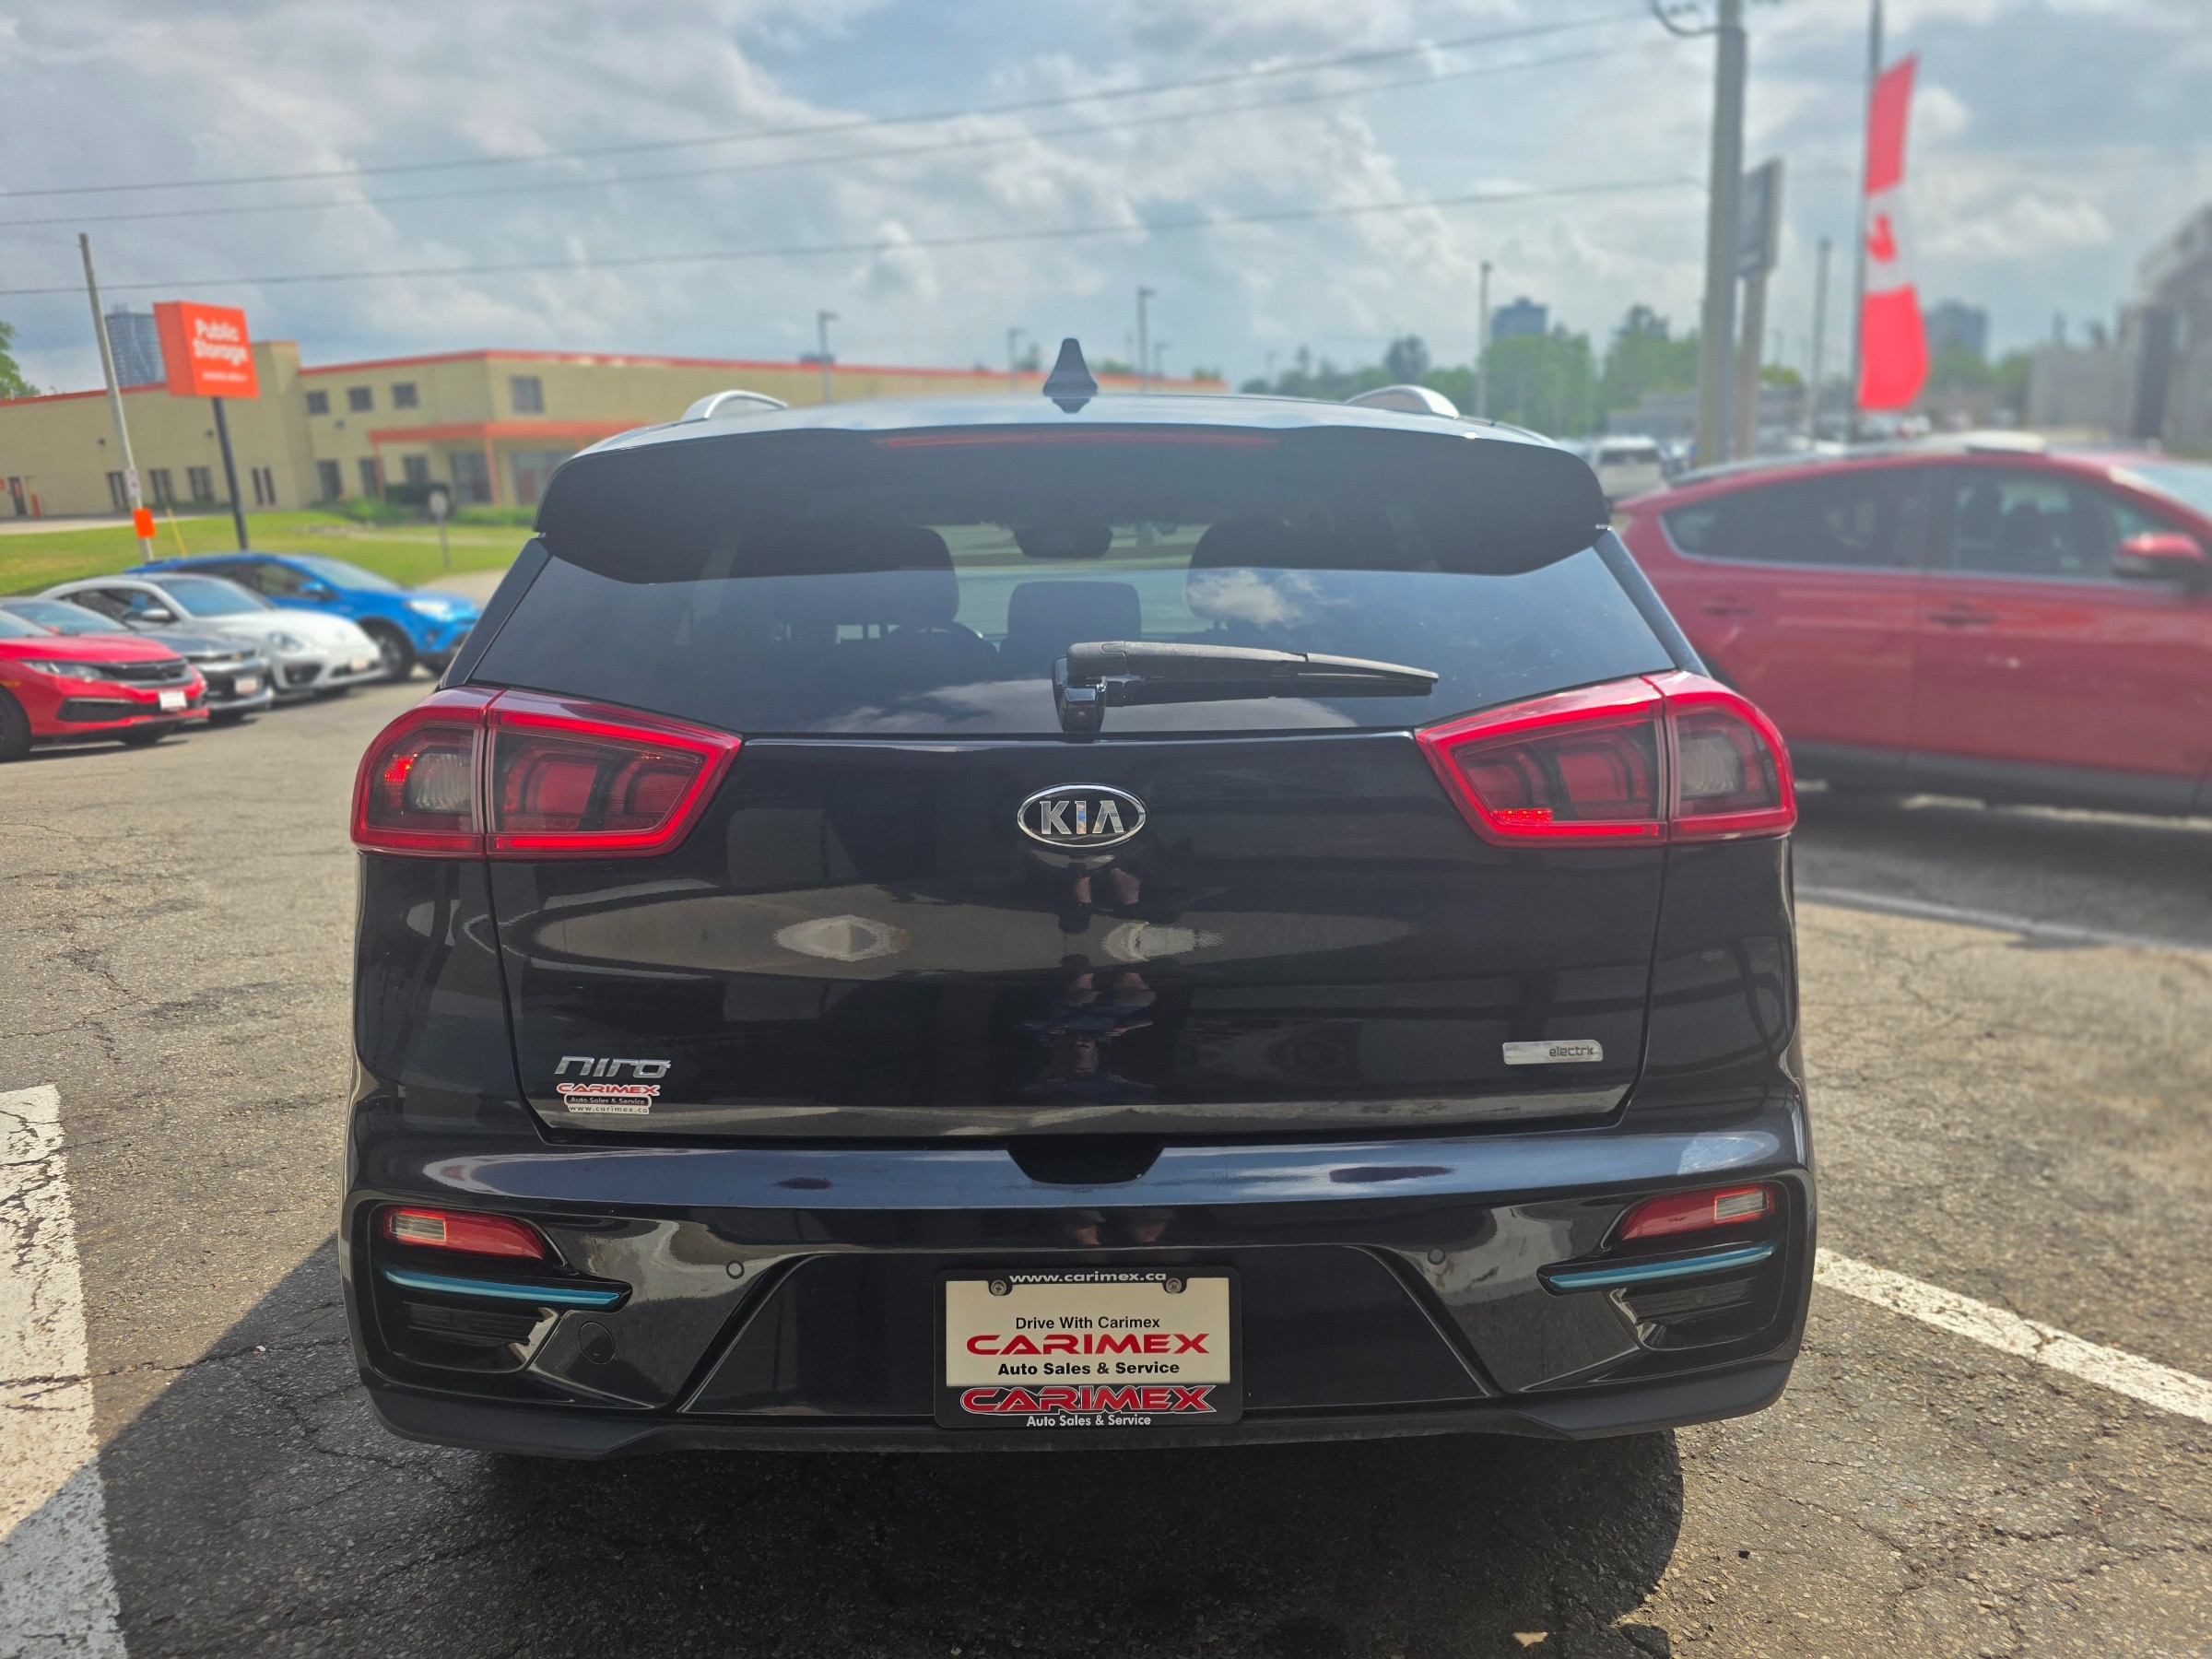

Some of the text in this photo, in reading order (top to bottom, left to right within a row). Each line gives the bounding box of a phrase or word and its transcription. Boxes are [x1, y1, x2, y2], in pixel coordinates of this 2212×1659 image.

[1039, 800, 1124, 835] KIA
[1548, 1045, 1594, 1057] electric
[557, 1083, 660, 1096] CARIMEX
[1008, 1271, 1167, 1283] www.carimex.ca
[1015, 1316, 1160, 1330] Drive With Carimex
[966, 1333, 1210, 1356] CARIMEX
[997, 1361, 1180, 1376] Auto Sales & Service
[959, 1385, 1217, 1415] CARIMEX
[1026, 1414, 1152, 1428] Auto Sales & Service
